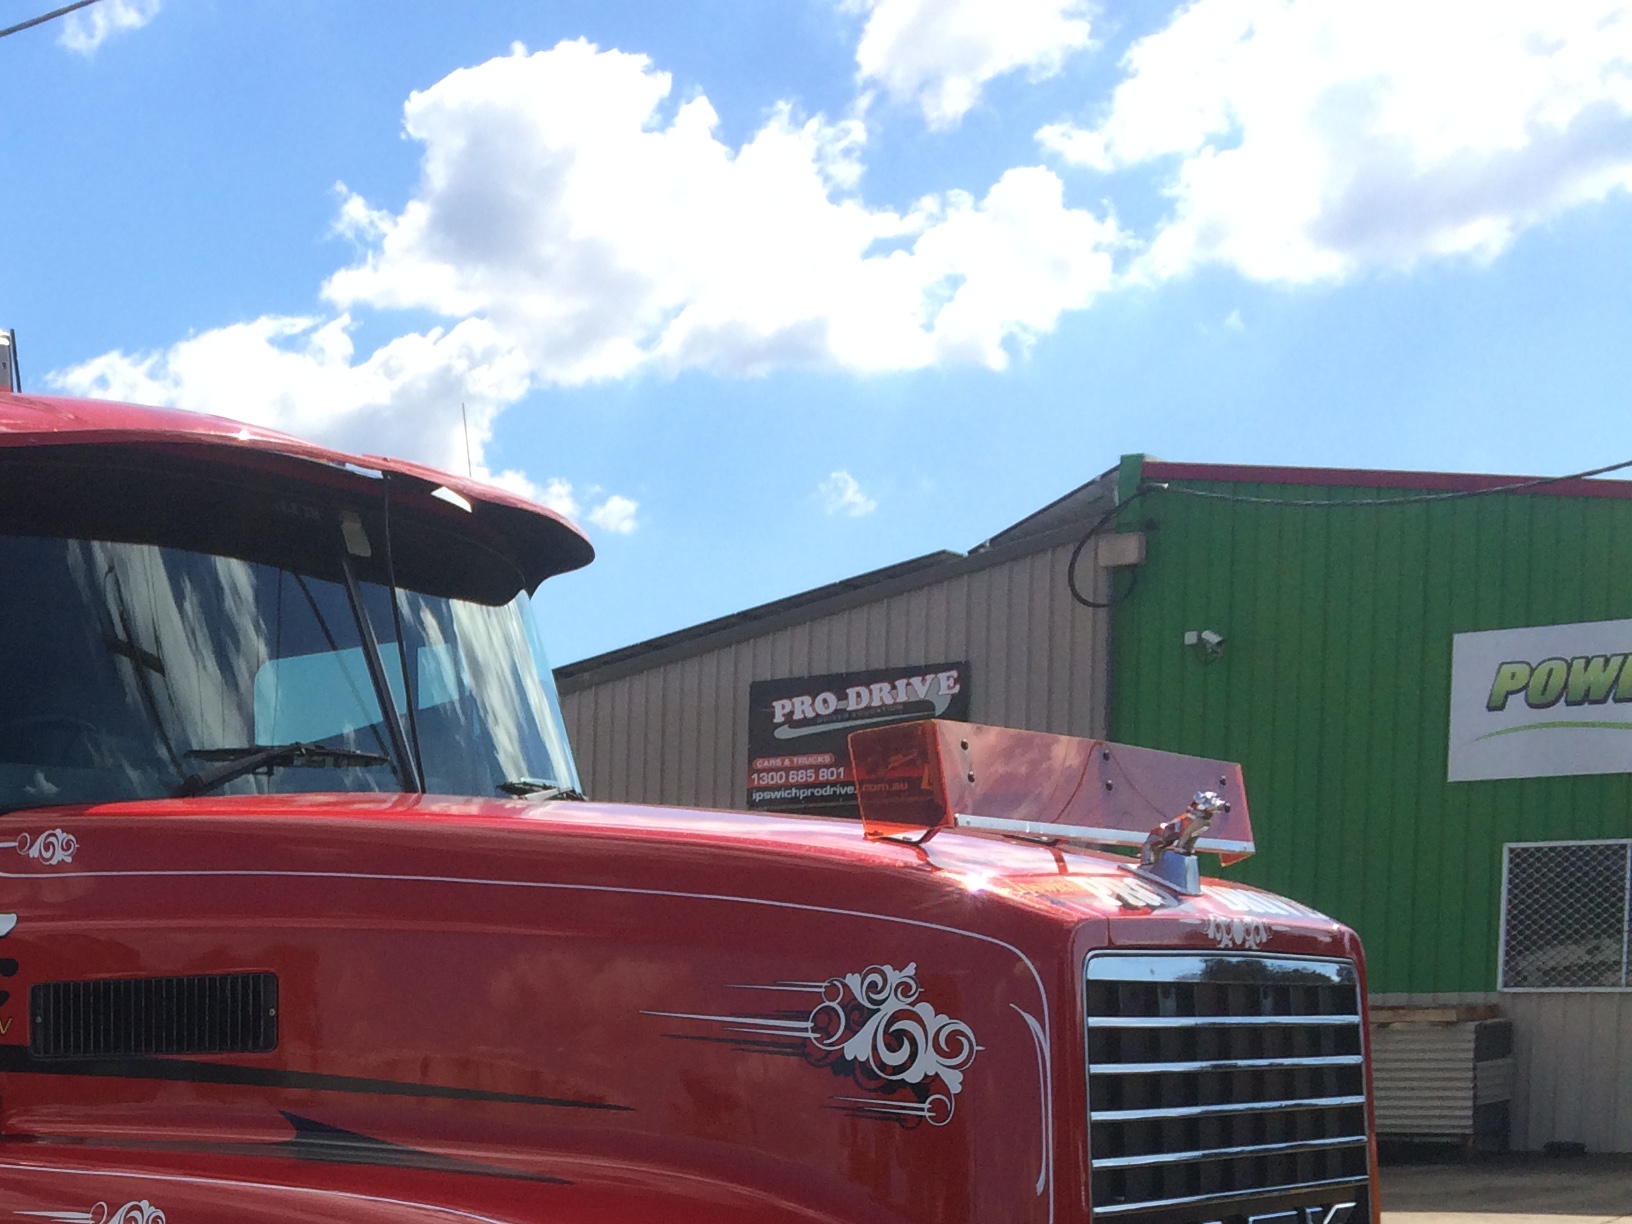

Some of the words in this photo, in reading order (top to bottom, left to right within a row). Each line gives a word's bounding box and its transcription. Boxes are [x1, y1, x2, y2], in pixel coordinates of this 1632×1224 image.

[756, 758, 781, 768] CARS
[793, 754, 831, 765] TRUCKS
[751, 771, 786, 785] 1300
[789, 769, 815, 782] 685
[819, 767, 844, 780] 801
